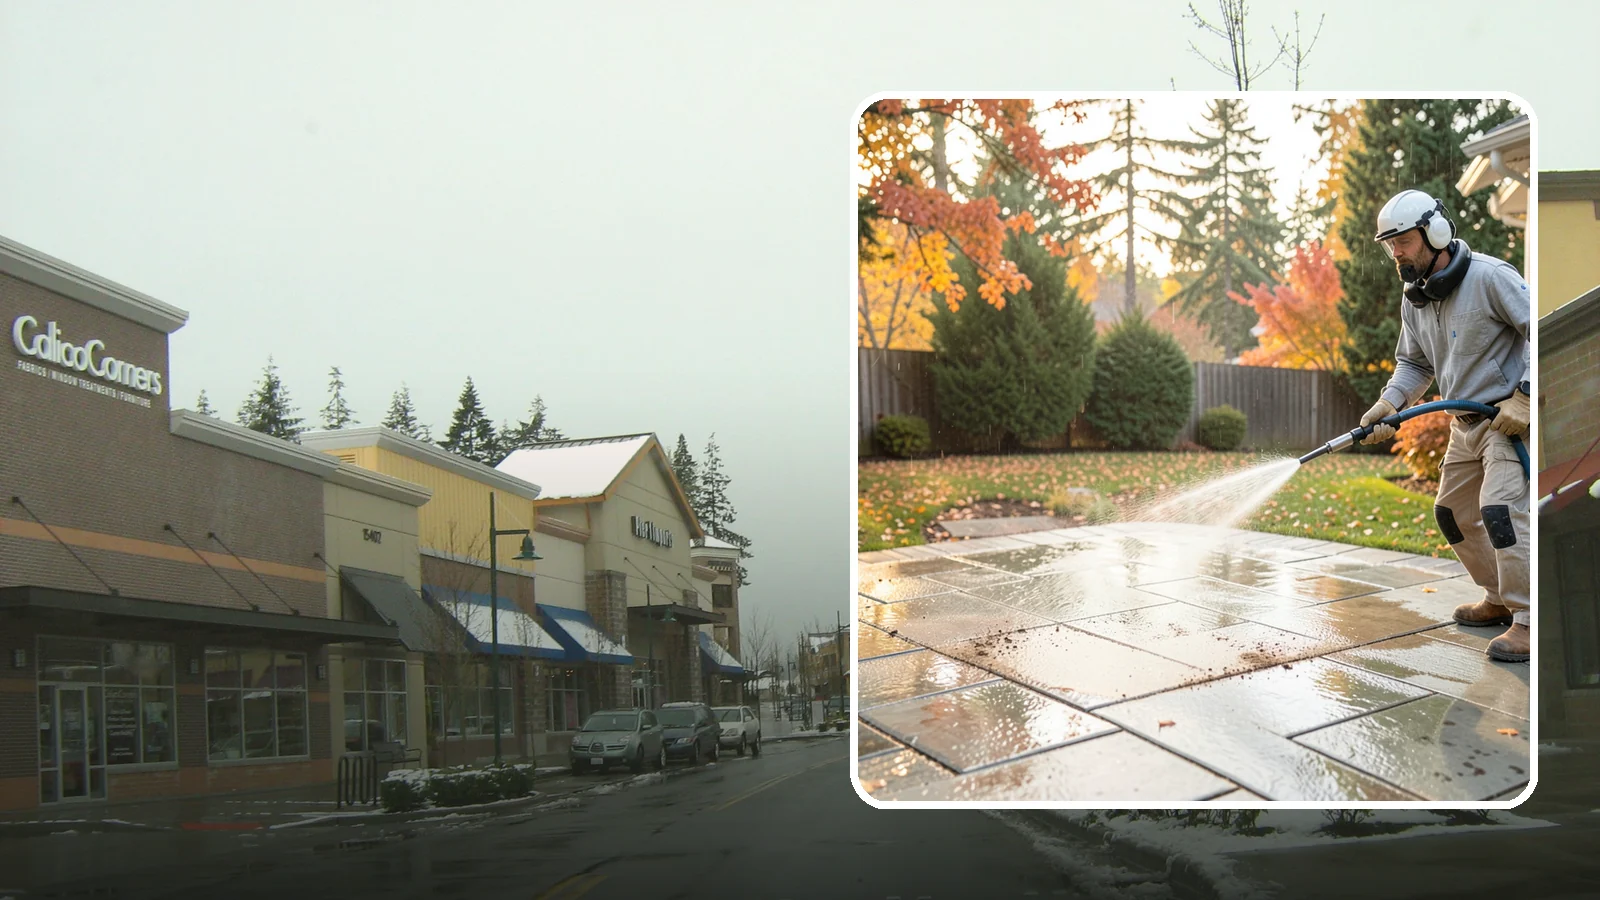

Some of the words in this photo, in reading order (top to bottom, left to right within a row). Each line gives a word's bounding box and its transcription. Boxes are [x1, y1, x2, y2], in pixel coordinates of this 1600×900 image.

[17, 360, 47, 377] FABRICS
[51, 370, 78, 386] WINDOW
[79, 378, 116, 398] TREATMENTS
[120, 390, 151, 408] FURNITURE
